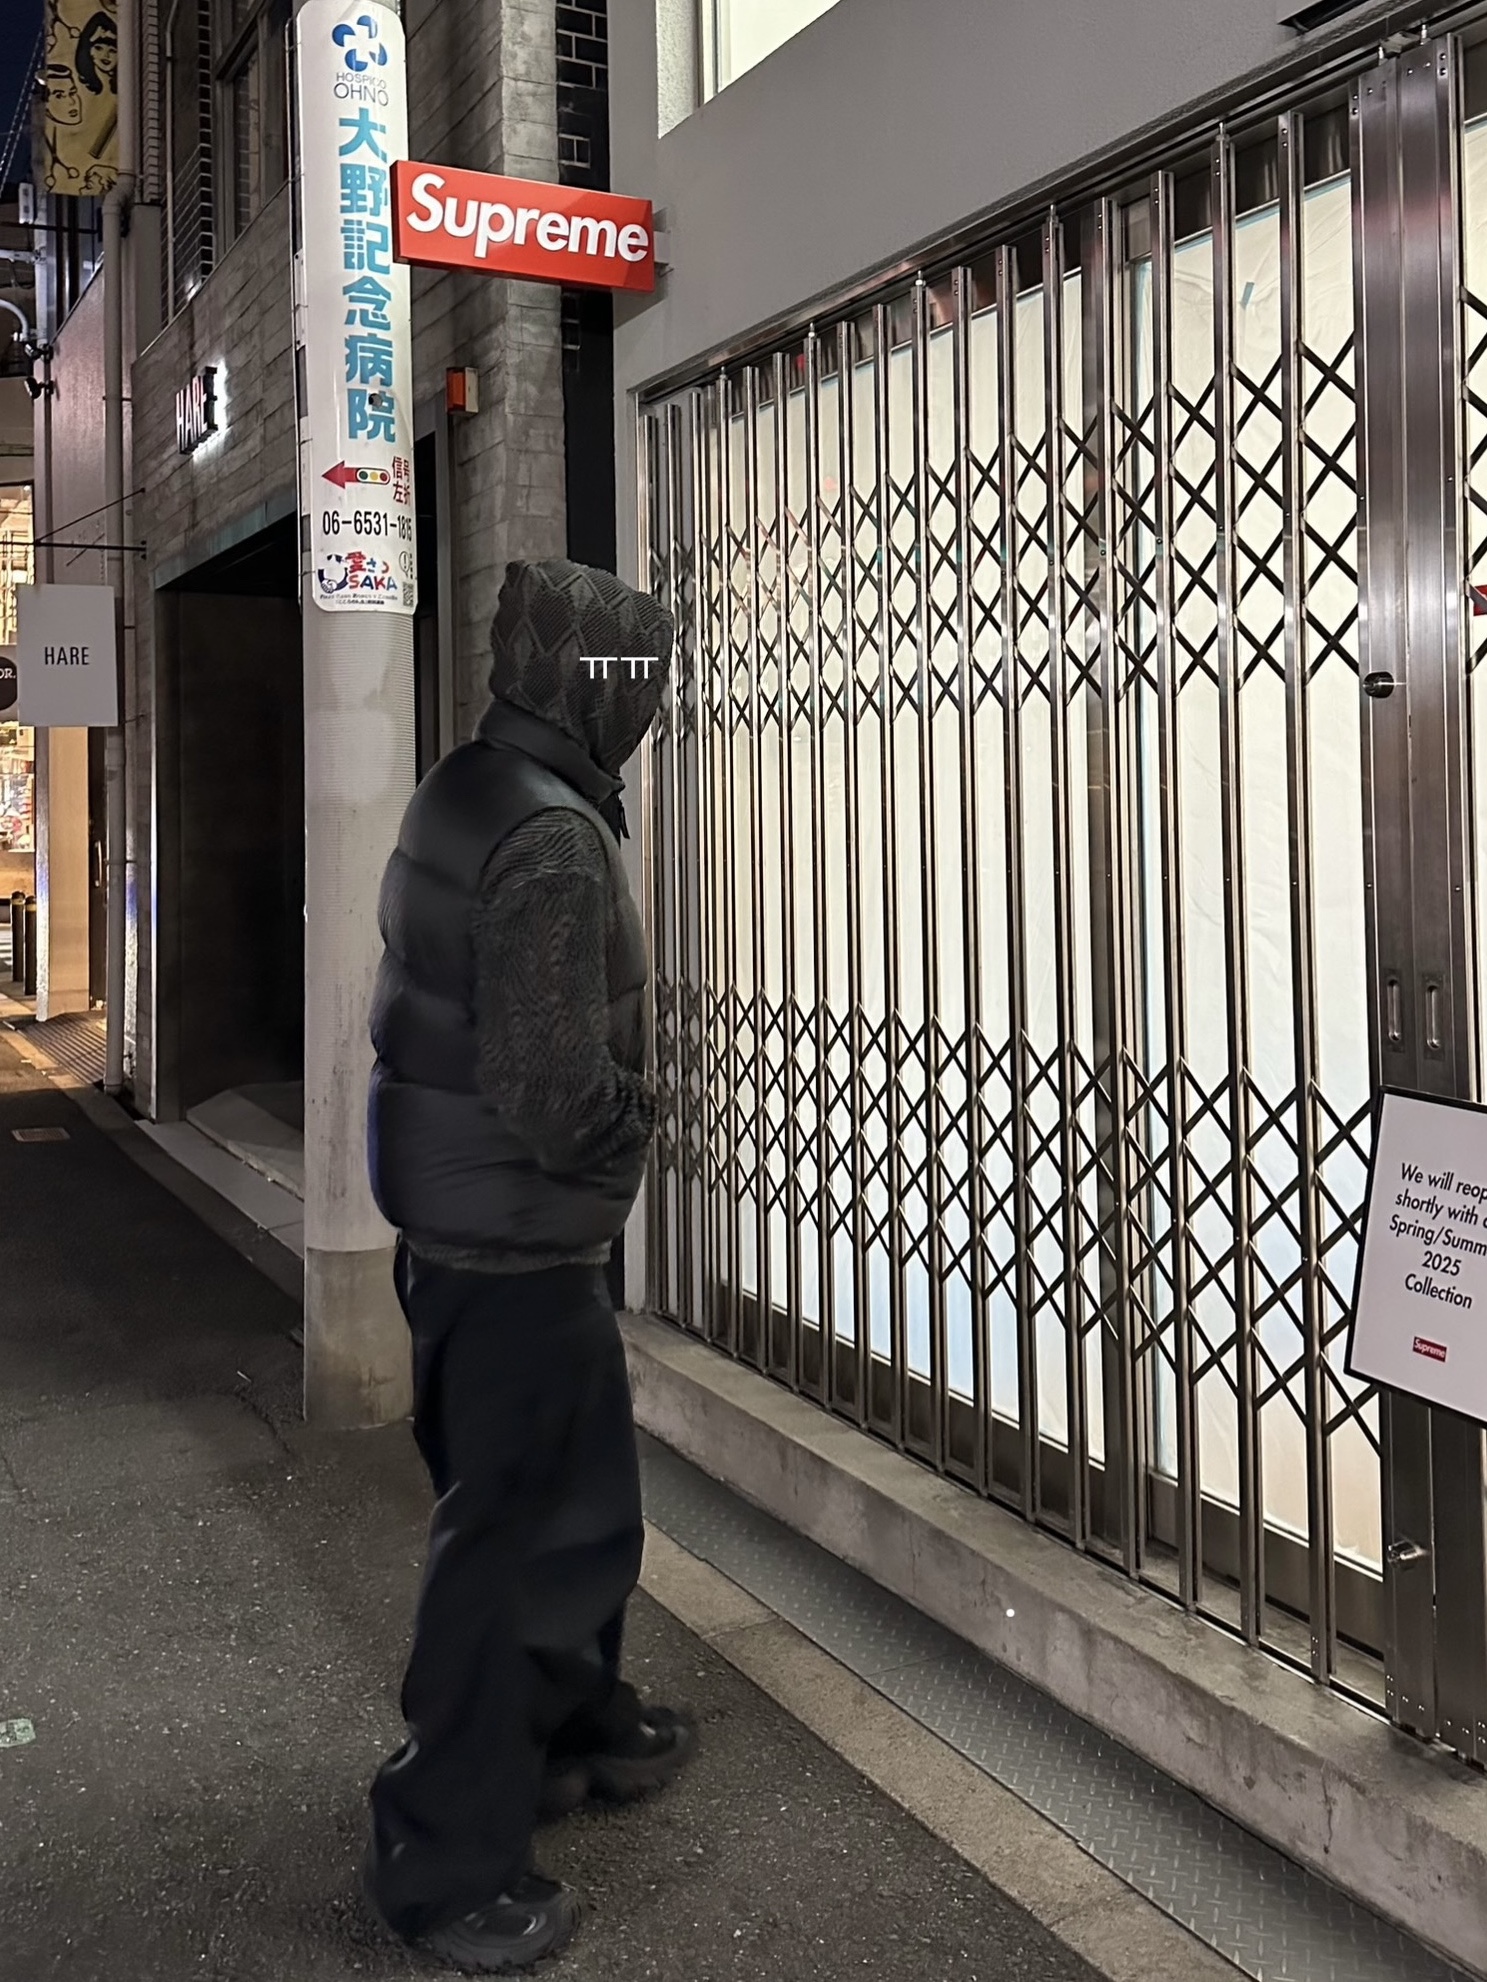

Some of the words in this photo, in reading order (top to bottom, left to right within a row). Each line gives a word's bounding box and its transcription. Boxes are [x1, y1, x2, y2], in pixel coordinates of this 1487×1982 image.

[333, 82, 389, 107] OHNO
[406, 172, 650, 263] Supreme
[338, 106, 396, 444] 大野記念病院
[175, 373, 209, 454] HARE
[44, 646, 90, 666] HARE
[1401, 1162, 1424, 1184] We
[1428, 1171, 1455, 1191] will
[1395, 1188, 1444, 1220] shortly
[1447, 1204, 1478, 1226] with
[1422, 1250, 1462, 1276] 2025
[1405, 1273, 1473, 1310] Collection
[1414, 1338, 1446, 1359] Supreme
